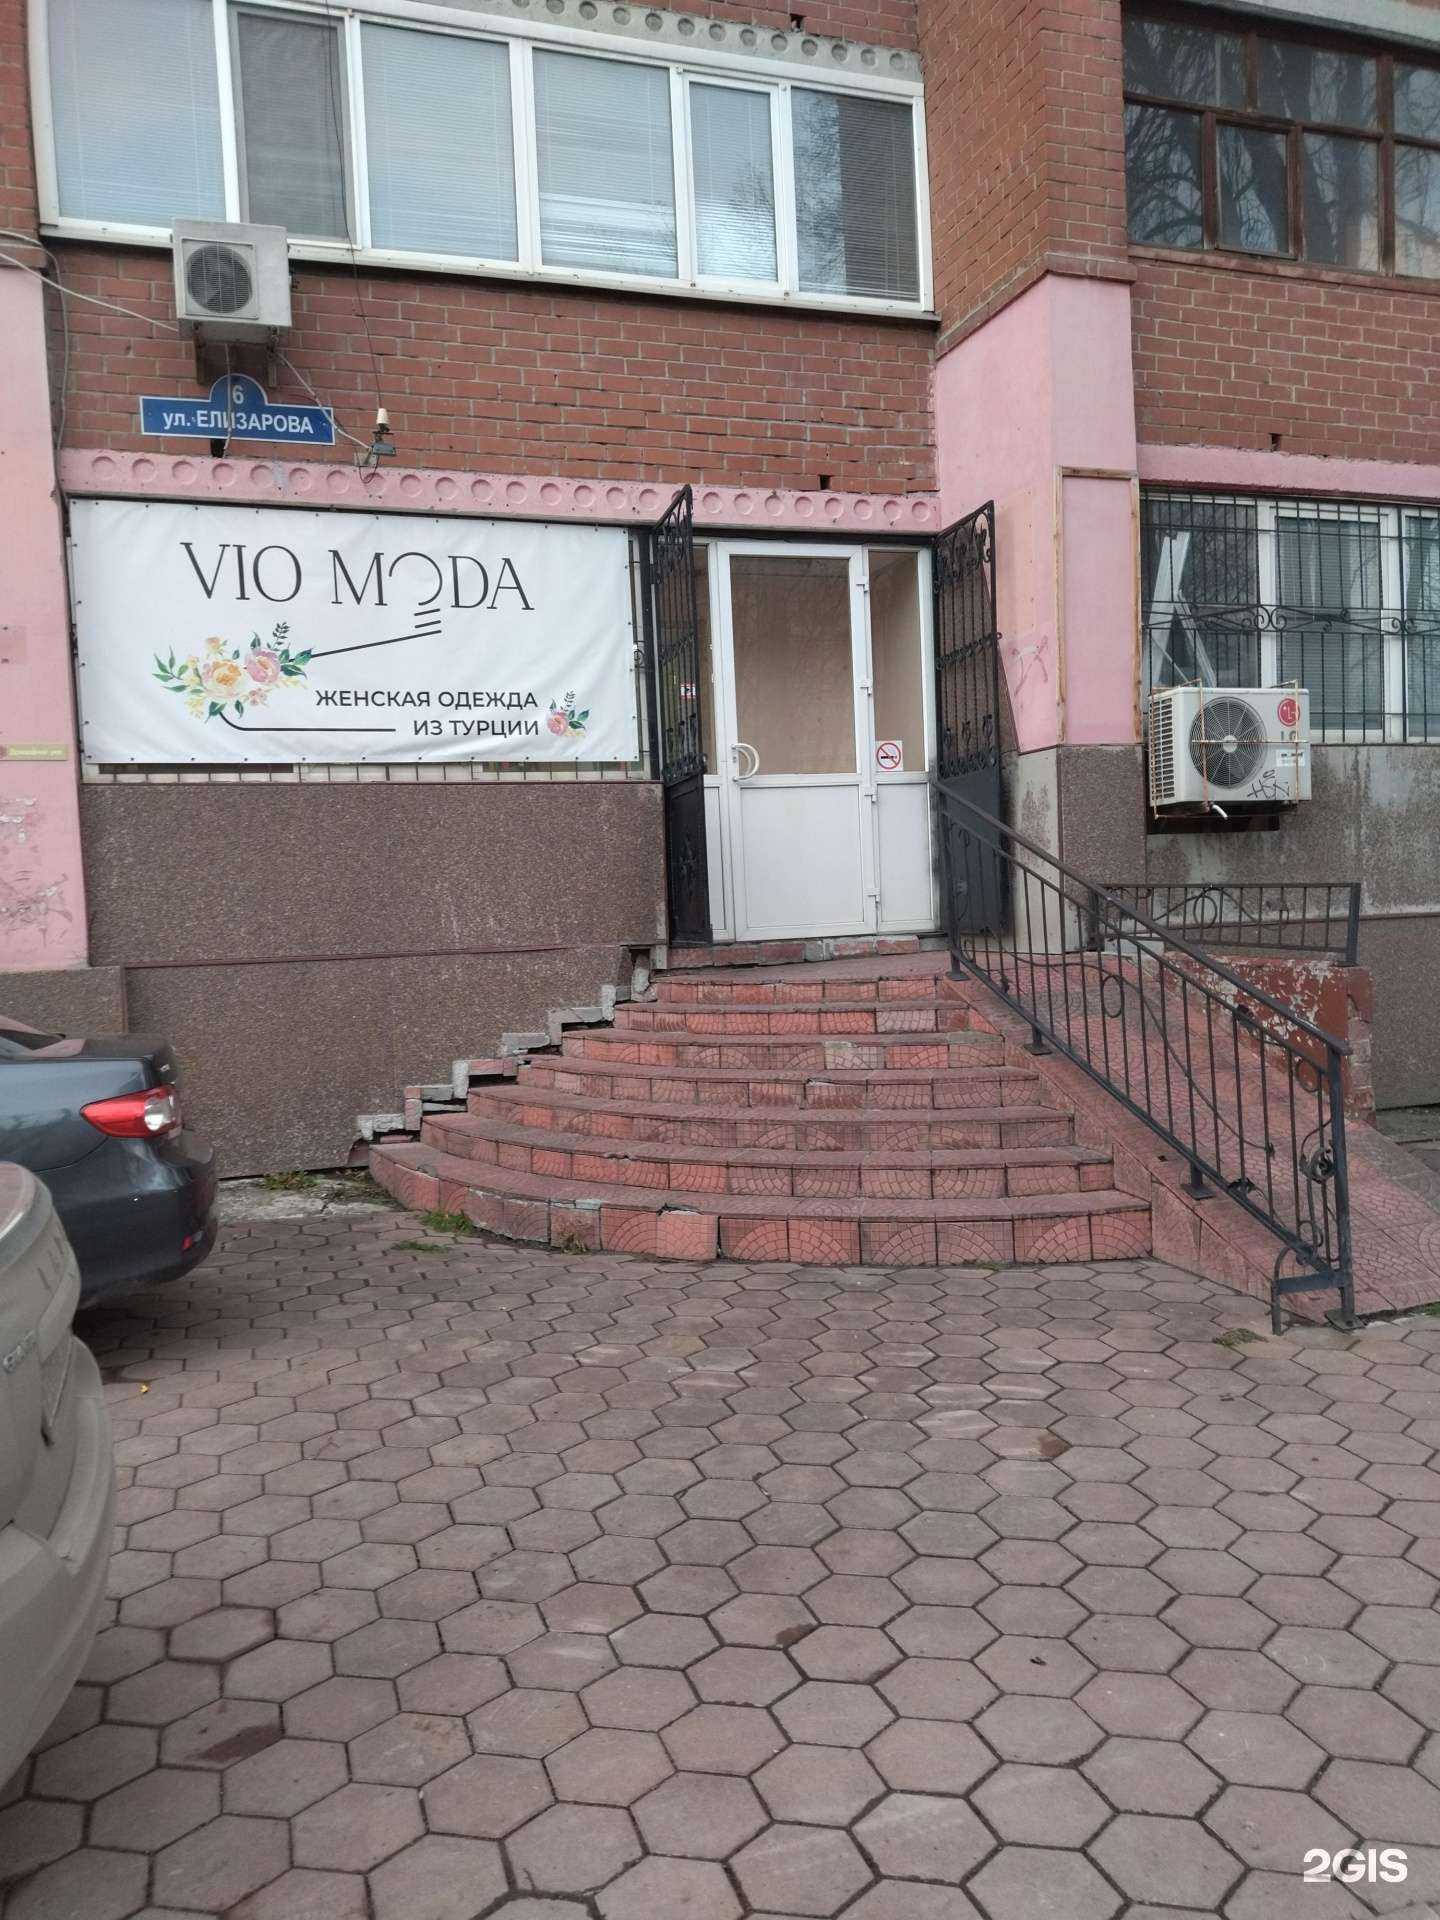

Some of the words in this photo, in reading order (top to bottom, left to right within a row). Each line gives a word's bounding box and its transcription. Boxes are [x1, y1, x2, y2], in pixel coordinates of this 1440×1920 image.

[232, 385, 244, 404] 6
[162, 411, 191, 430] ул.
[196, 410, 314, 434] ЕЛИЗАРОВА
[180, 542, 301, 602] VIO
[328, 550, 535, 611] MODA
[316, 690, 430, 708] ЖЕНСКАЯ
[438, 691, 538, 711] ОДЕЖДА
[414, 720, 443, 737] ИЗ
[449, 720, 540, 740] ТУРЦИИ
